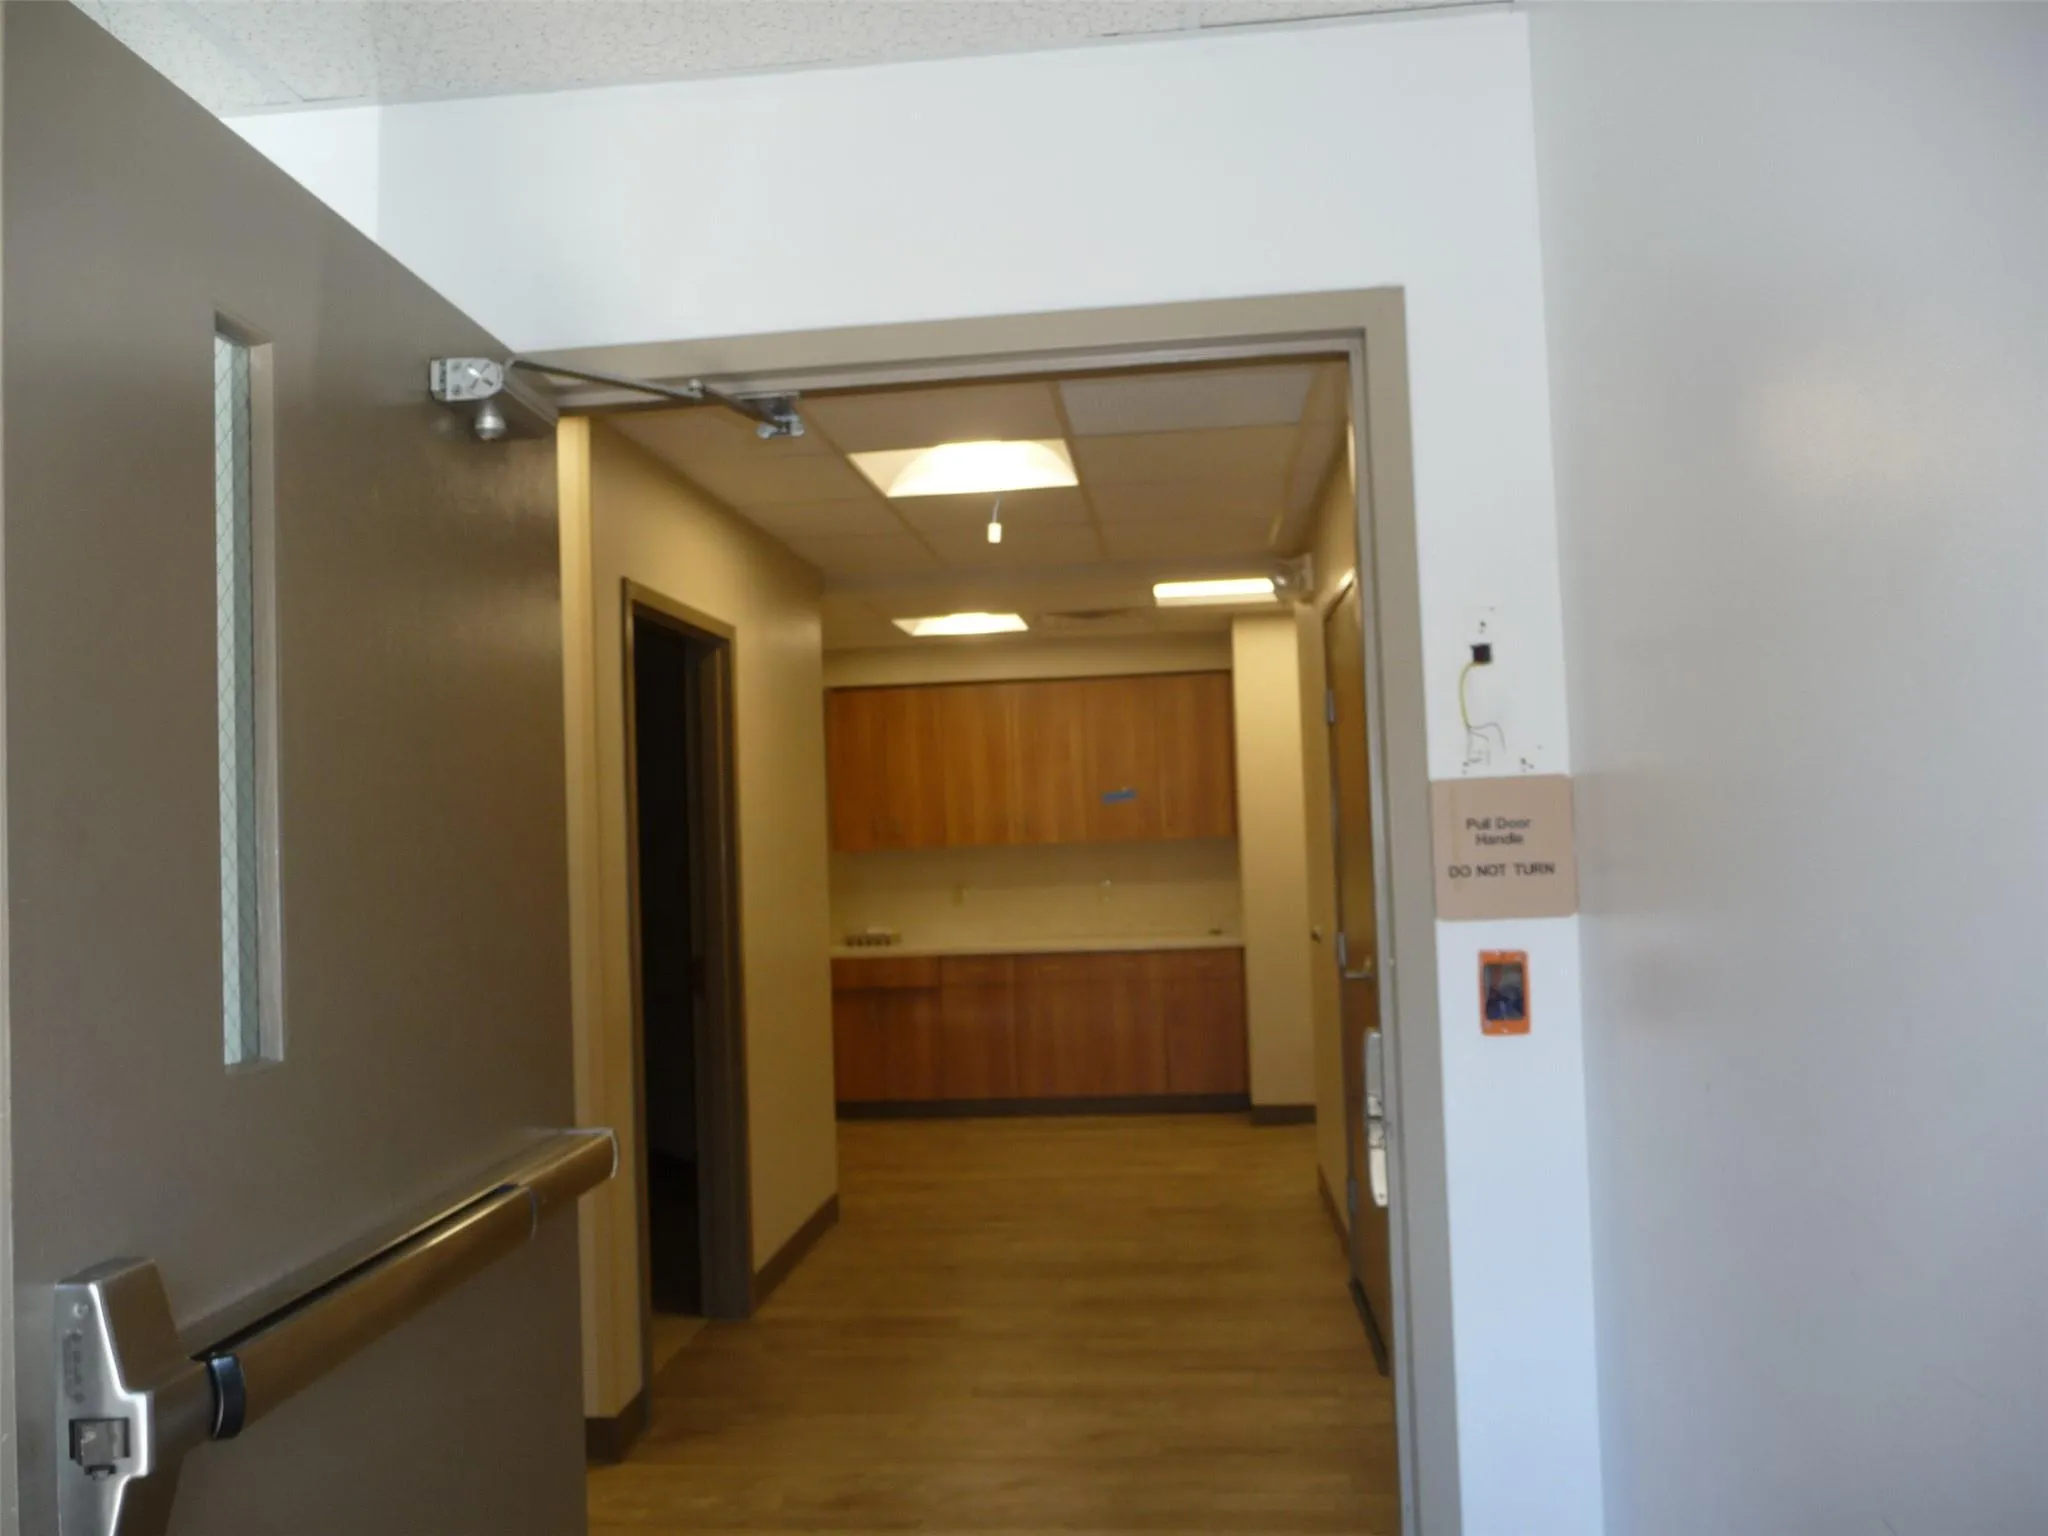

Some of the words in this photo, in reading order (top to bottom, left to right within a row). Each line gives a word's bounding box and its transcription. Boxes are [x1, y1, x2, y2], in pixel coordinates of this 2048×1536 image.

[1466, 817, 1491, 830] Pull
[1496, 816, 1531, 830] Door
[1475, 832, 1524, 845] Handle
[1448, 864, 1472, 878] DO
[1476, 863, 1506, 877] NOT
[1514, 862, 1556, 876] TURN
